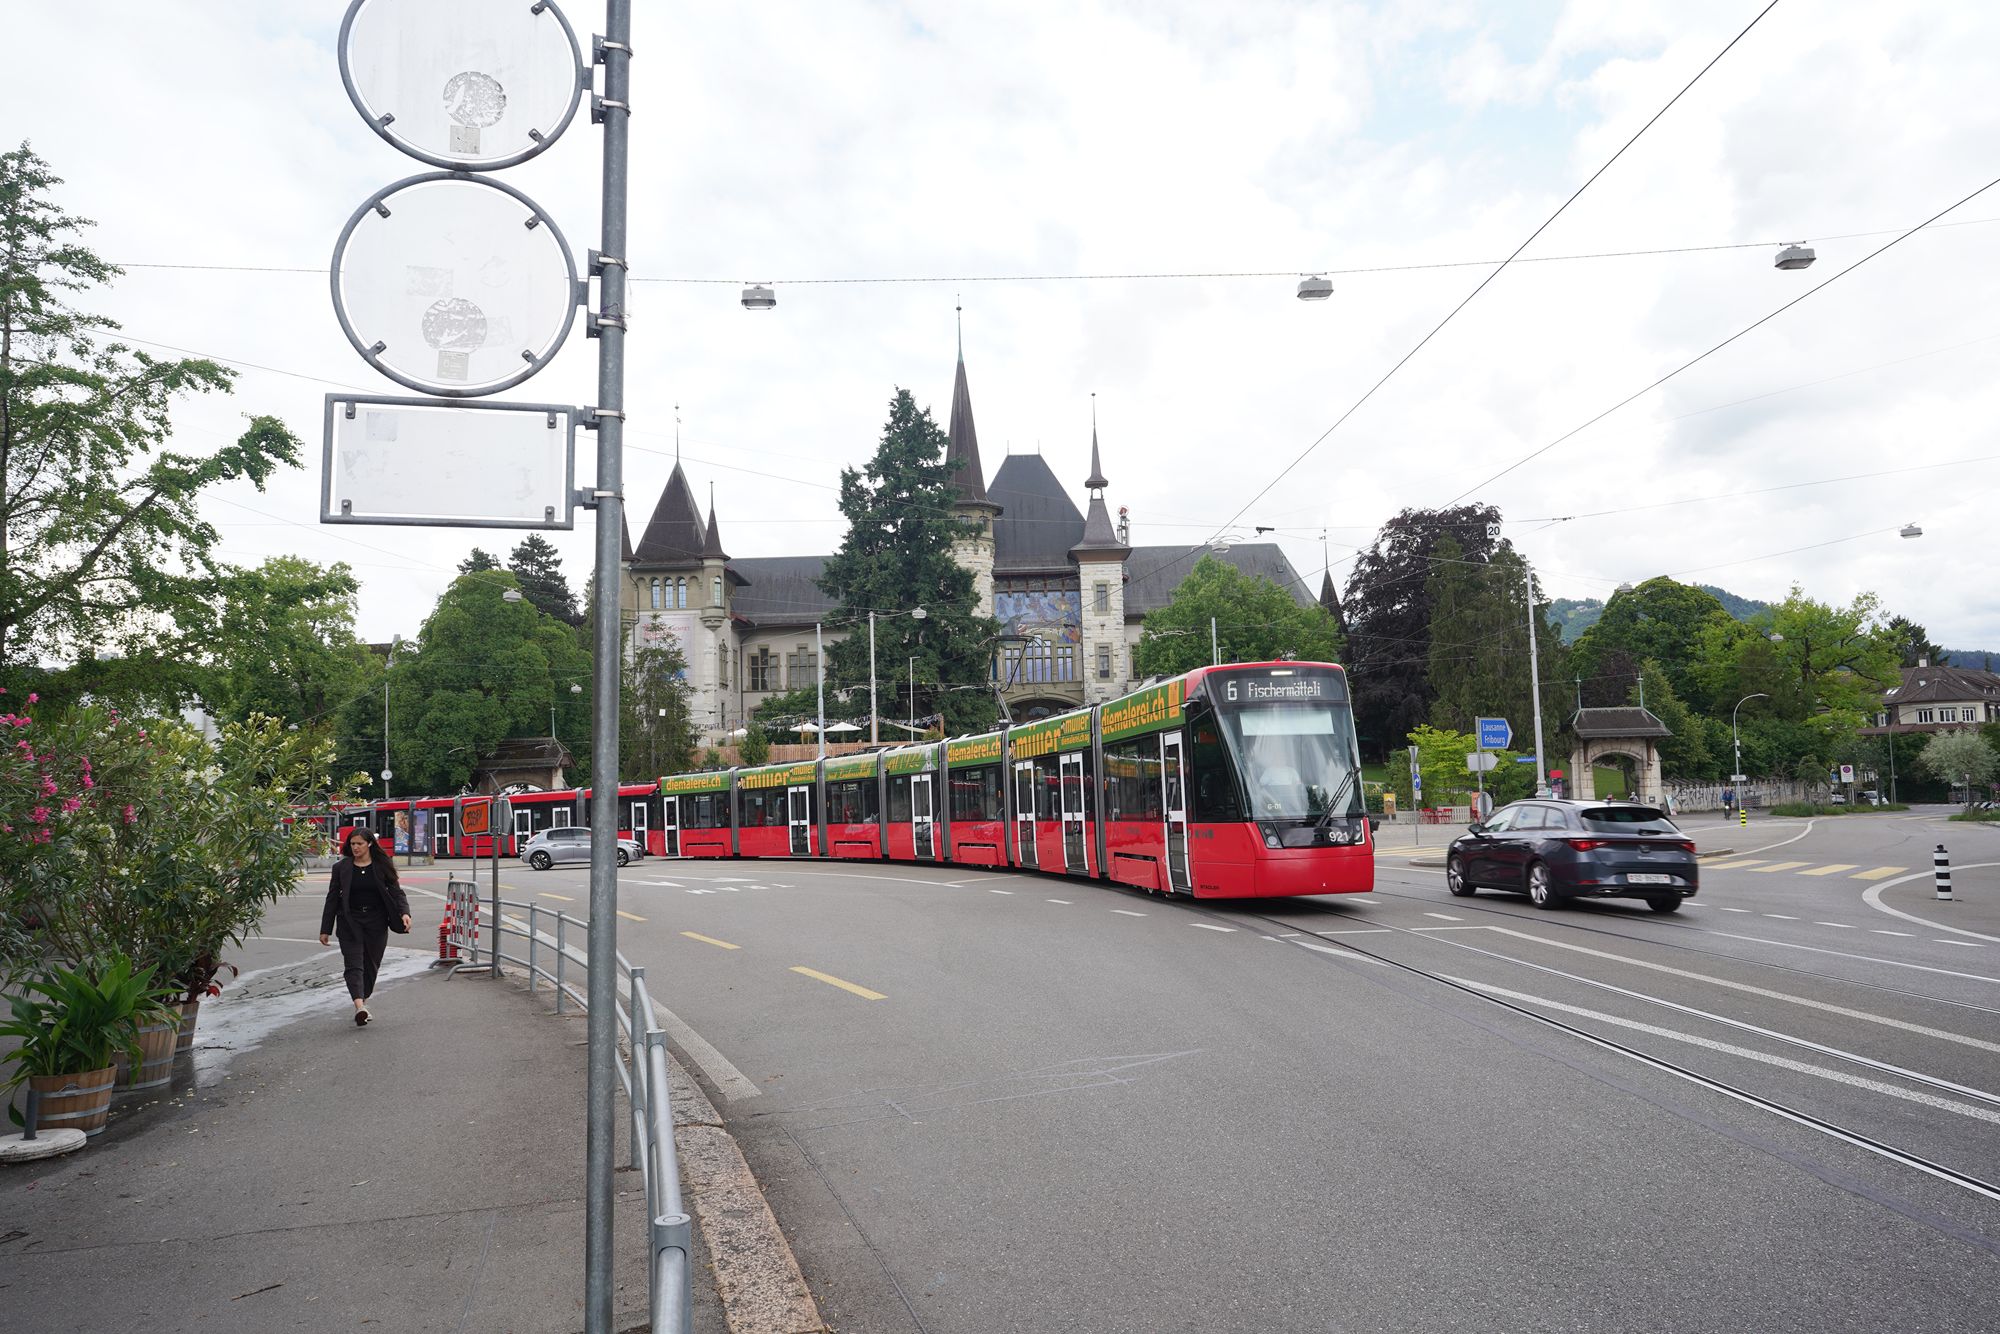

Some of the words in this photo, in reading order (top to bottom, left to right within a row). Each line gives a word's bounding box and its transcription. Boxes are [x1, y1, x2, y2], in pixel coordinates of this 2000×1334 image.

[1227, 680, 1238, 701] 6
[1248, 681, 1321, 698] Fischermätteli
[1101, 687, 1166, 736] diemalerei.ch
[1482, 722, 1506, 732] Lausanne
[948, 735, 1002, 763] diemalerei.ch
[1016, 724, 1060, 759] müller
[1484, 734, 1506, 747] Fribourg
[666, 774, 721, 792] diemalerei.ch
[1329, 831, 1349, 842] 921
